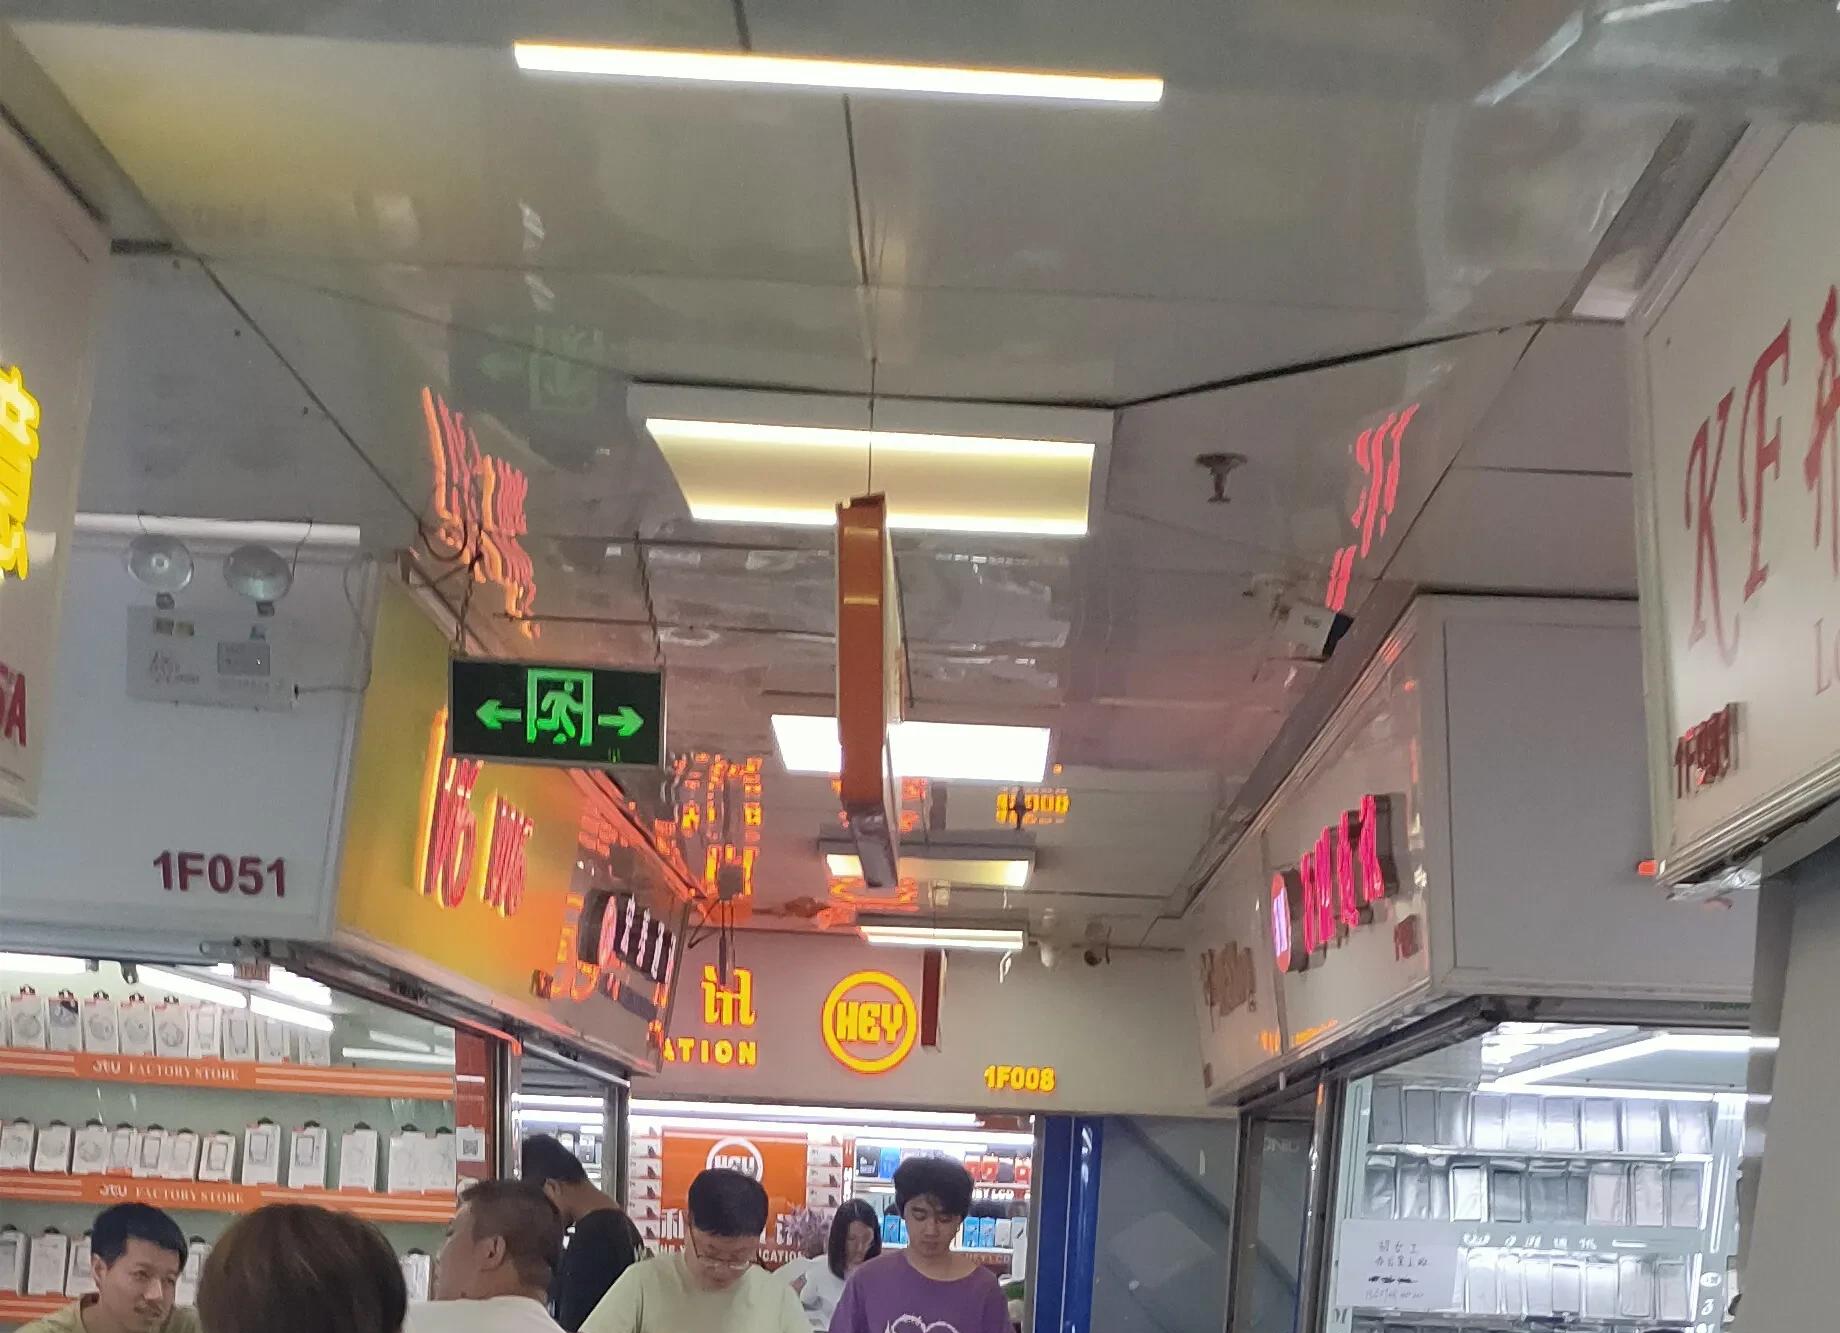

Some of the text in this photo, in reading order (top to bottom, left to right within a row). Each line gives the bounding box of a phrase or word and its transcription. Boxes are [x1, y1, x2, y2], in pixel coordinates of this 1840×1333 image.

[153, 850, 285, 897] 1F051
[836, 1000, 904, 1044] HEY
[663, 1037, 757, 1066] ATION
[129, 1062, 191, 1078] FACTORY
[194, 1065, 240, 1082] STORE
[984, 1065, 1056, 1093] 1F008
[135, 1186, 197, 1202] FACTORY
[200, 1190, 244, 1205] STORE
